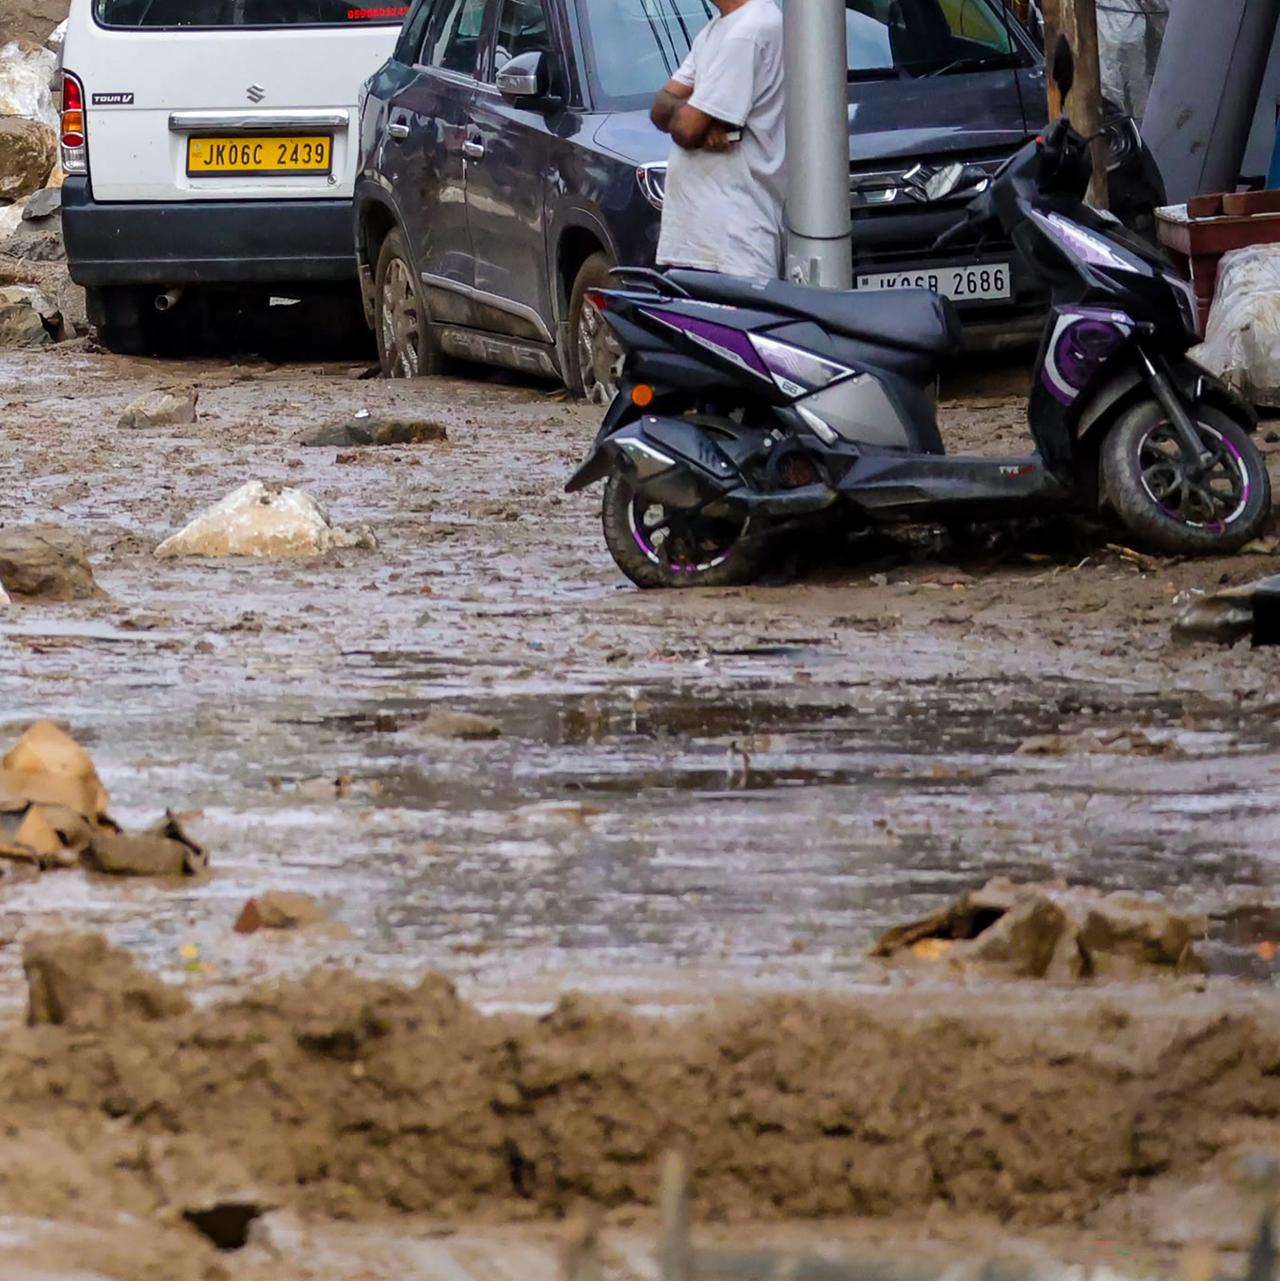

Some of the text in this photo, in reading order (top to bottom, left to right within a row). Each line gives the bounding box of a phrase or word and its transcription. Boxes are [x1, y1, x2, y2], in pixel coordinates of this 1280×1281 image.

[203, 143, 325, 165] JK06C 2439
[953, 269, 1004, 295] 2686
